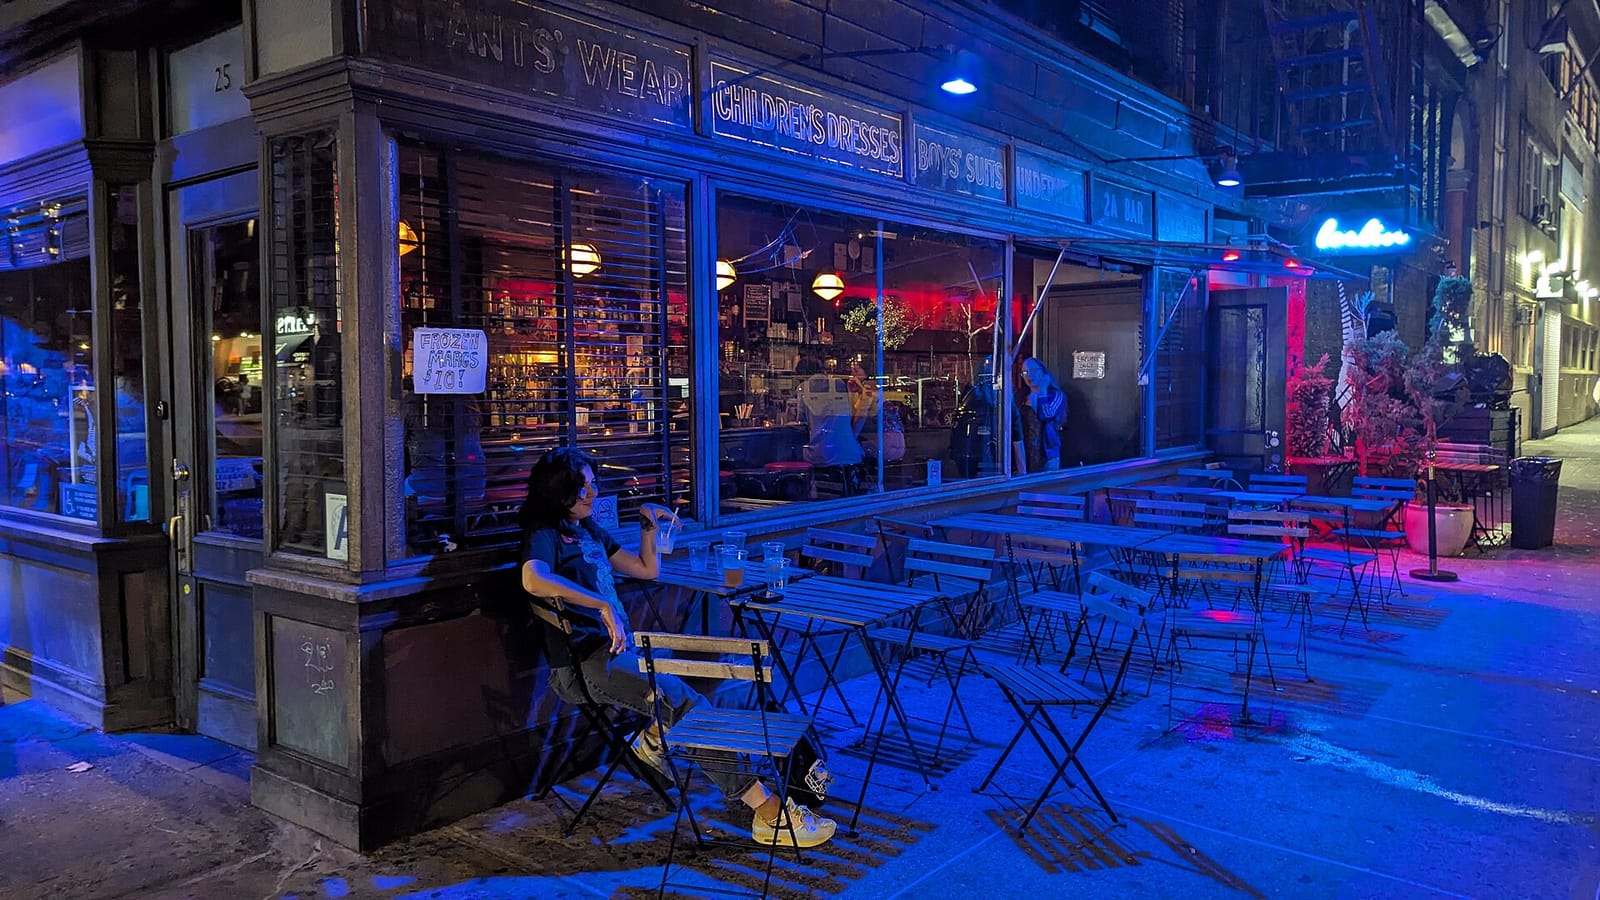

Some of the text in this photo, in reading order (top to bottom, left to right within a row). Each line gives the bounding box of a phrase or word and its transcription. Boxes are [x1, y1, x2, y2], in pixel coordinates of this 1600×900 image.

[215, 64, 231, 92] 25
[577, 39, 683, 107] WEAR
[715, 80, 900, 164] CHILDREN'S DRESSES
[918, 138, 1003, 189] BOYS' SUITS
[1103, 191, 1144, 225] 2A BAR
[420, 332, 480, 350] FROZEN
[428, 350, 480, 369] MARGS
